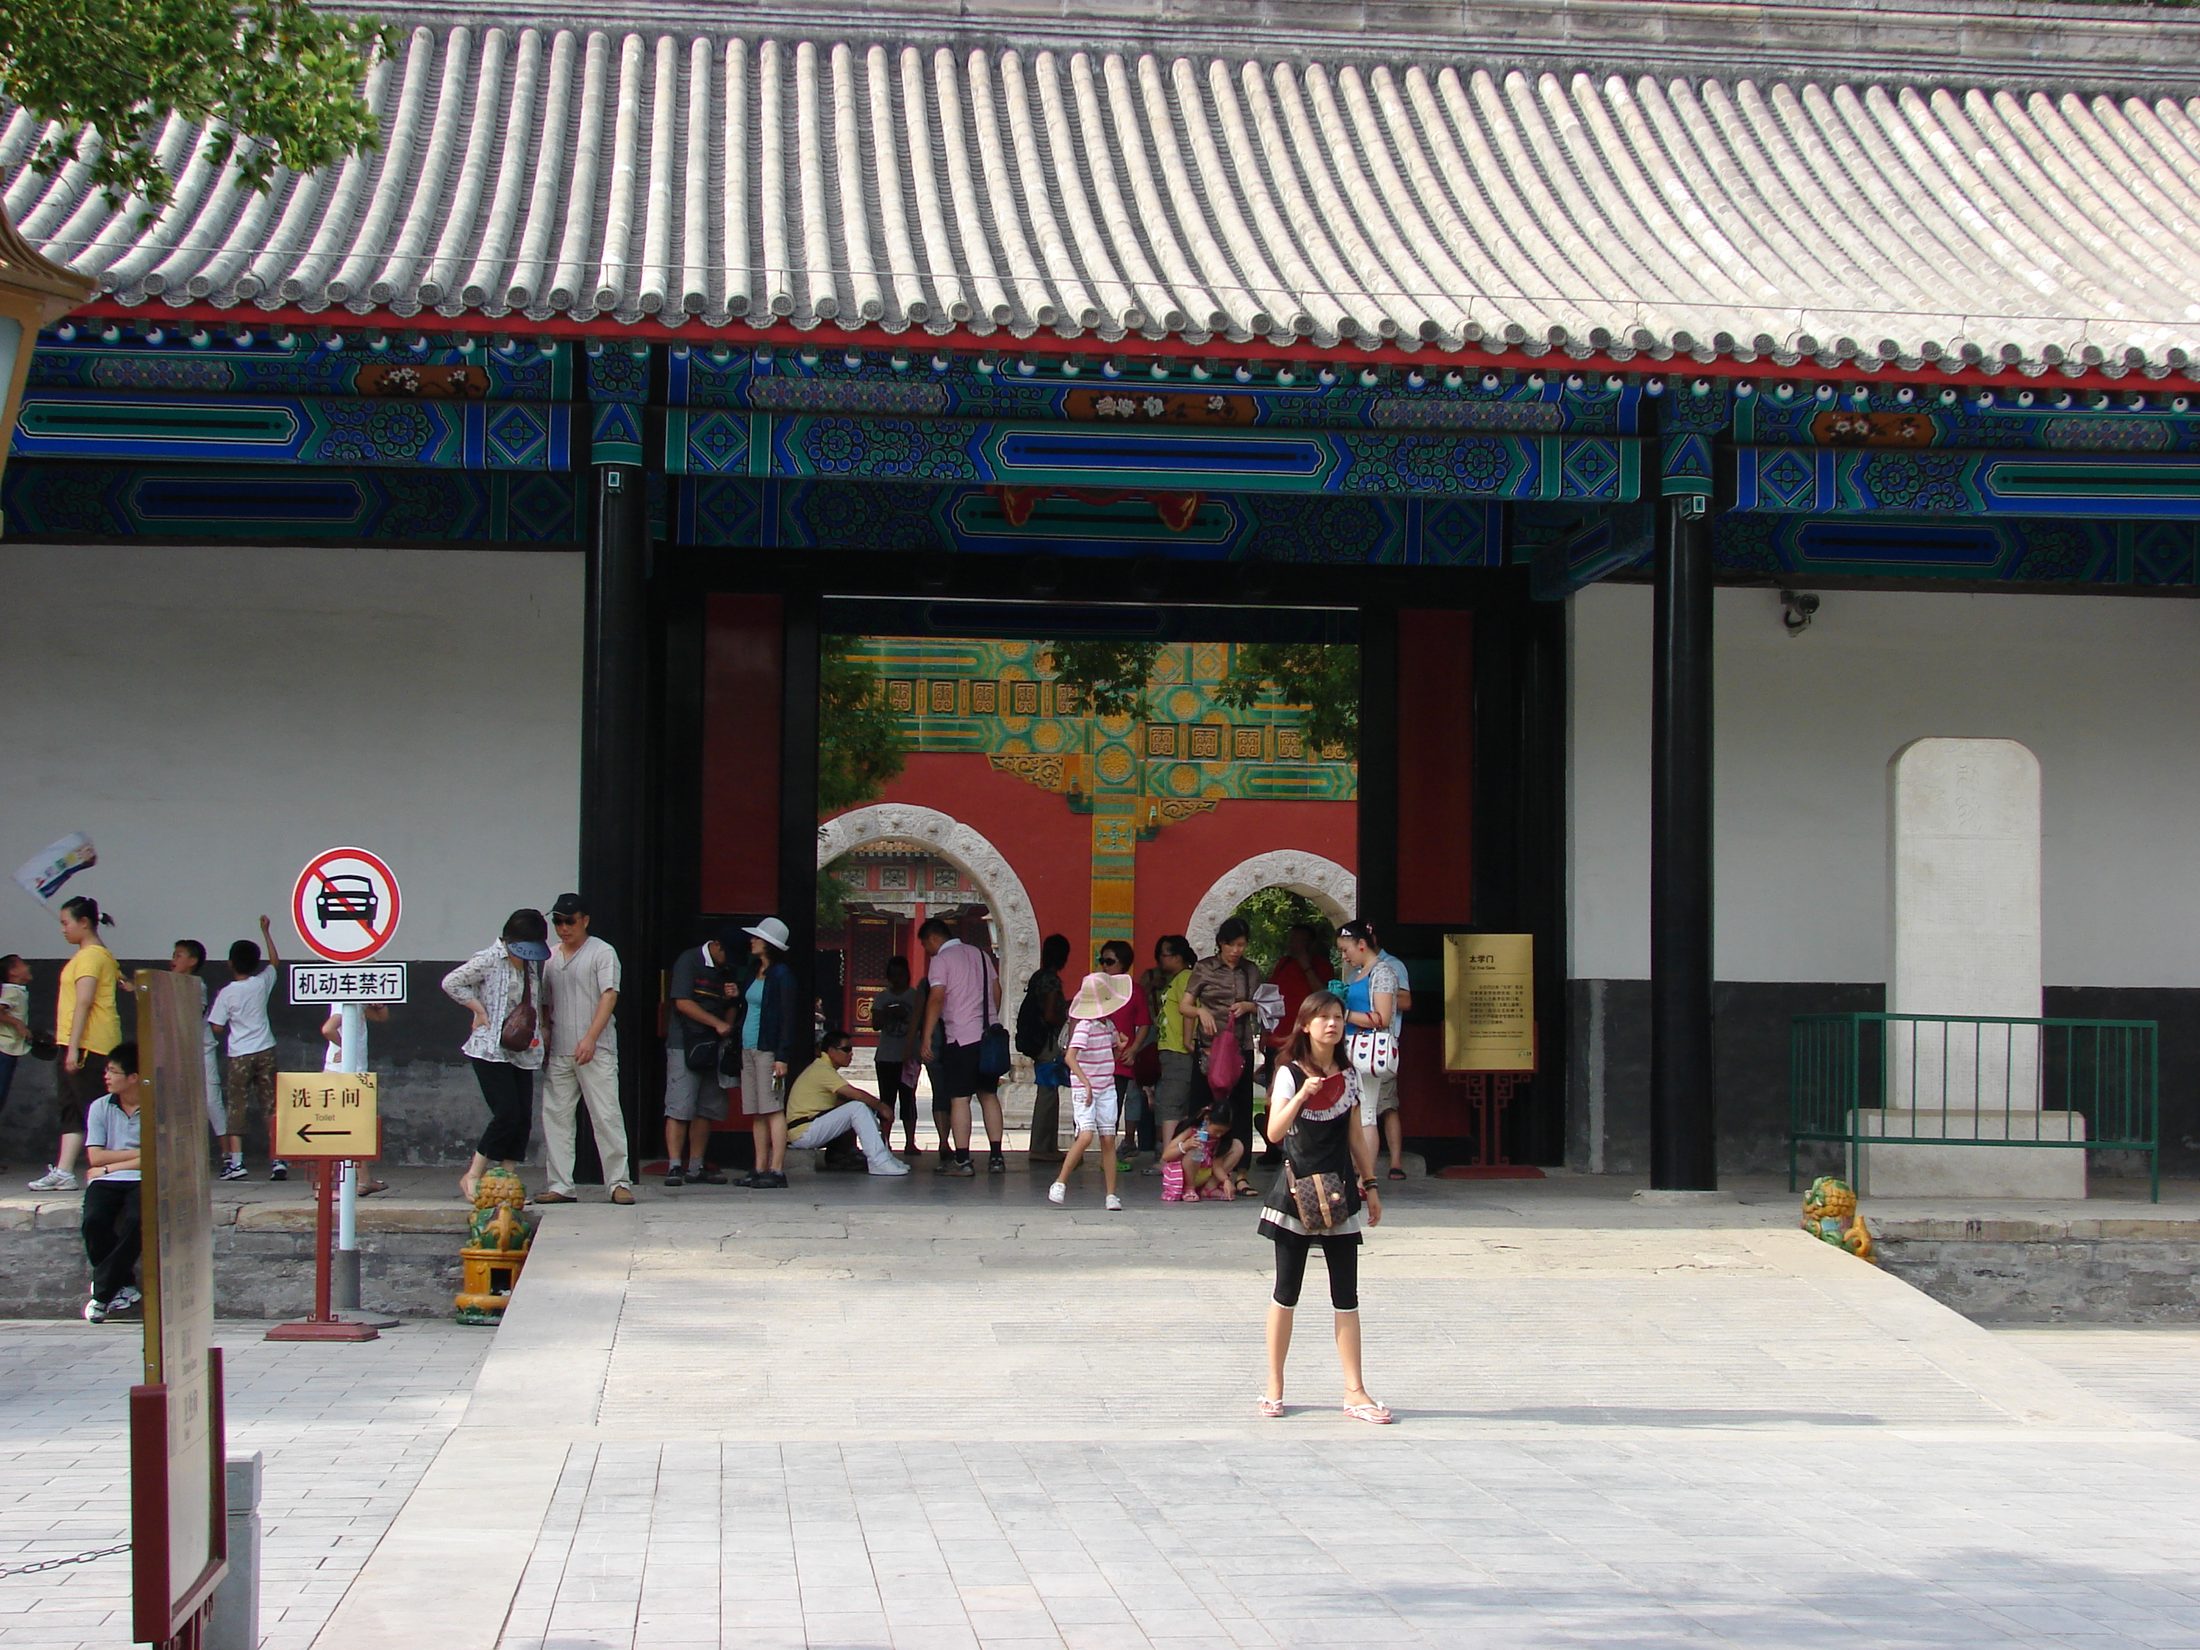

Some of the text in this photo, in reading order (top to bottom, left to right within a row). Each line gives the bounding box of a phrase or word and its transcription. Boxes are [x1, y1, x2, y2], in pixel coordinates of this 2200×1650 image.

[299, 973, 398, 994] 机动车禁行
[292, 1088, 360, 1108] 洗手间
[315, 1113, 336, 1121] Toilet
